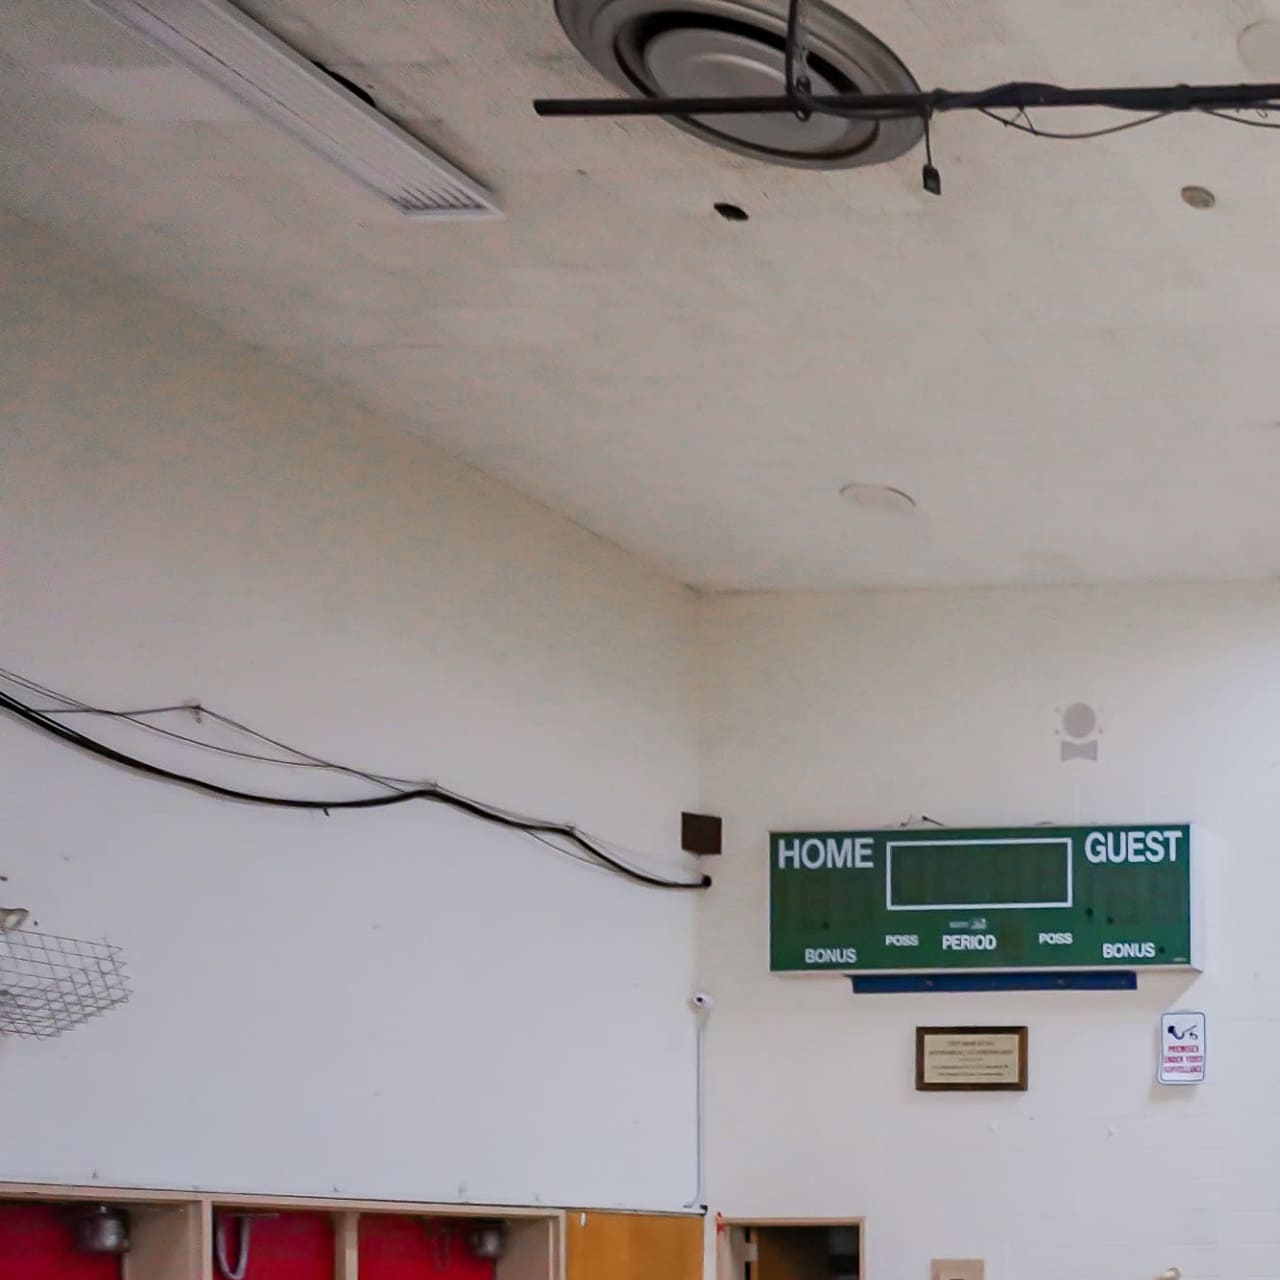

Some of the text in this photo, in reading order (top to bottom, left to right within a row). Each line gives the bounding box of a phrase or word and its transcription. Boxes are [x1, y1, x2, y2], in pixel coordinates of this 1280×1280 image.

[778, 838, 874, 869] HOME
[1085, 831, 1183, 863] GUEST
[885, 935, 919, 946] POSS
[942, 935, 997, 950] PERIOD
[1039, 932, 1073, 944] POSS
[805, 948, 857, 963] BONUS
[1103, 942, 1156, 958] BONUS
